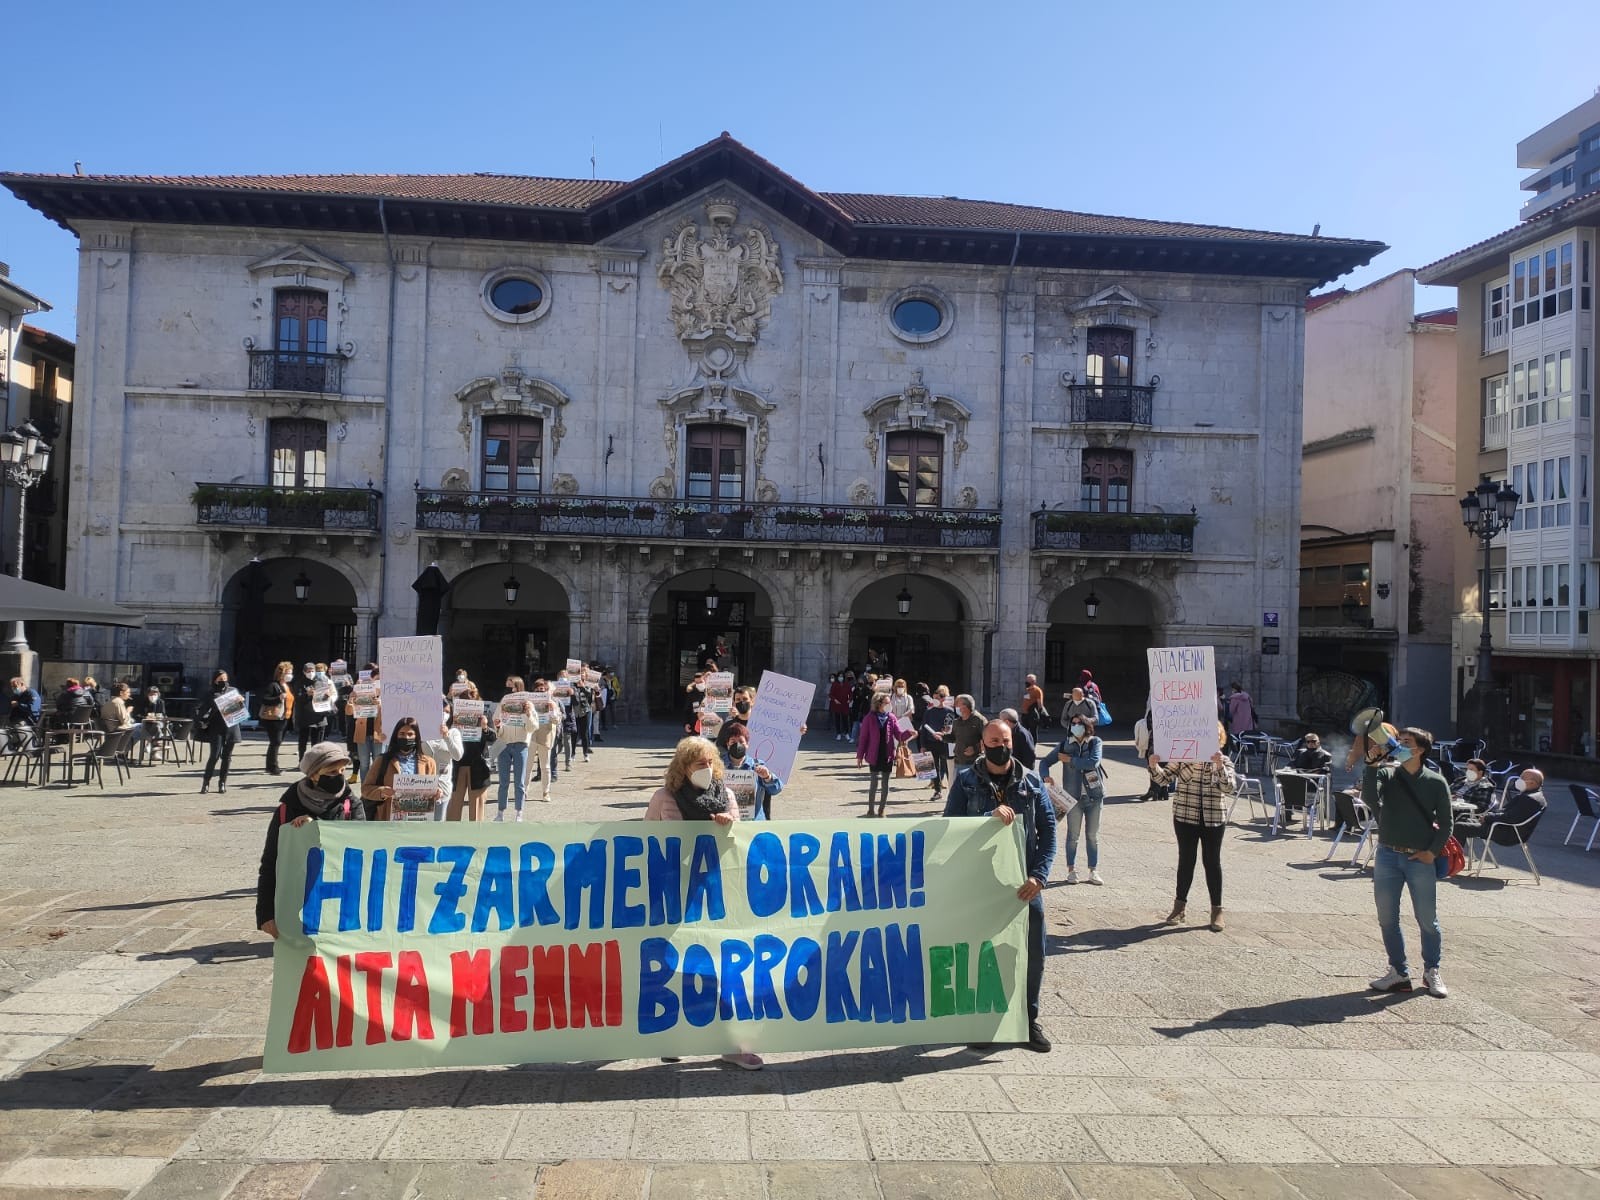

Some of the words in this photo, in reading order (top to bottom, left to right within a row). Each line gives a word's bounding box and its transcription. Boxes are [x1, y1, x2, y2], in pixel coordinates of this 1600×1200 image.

[302, 834, 726, 935] HITZARMENA
[747, 830, 927, 918] ORAIN!
[287, 949, 435, 1054] AITA
[449, 939, 624, 1038] MENNI
[637, 923, 927, 1035] BORROKAN
[929, 941, 1009, 1016] ELA
